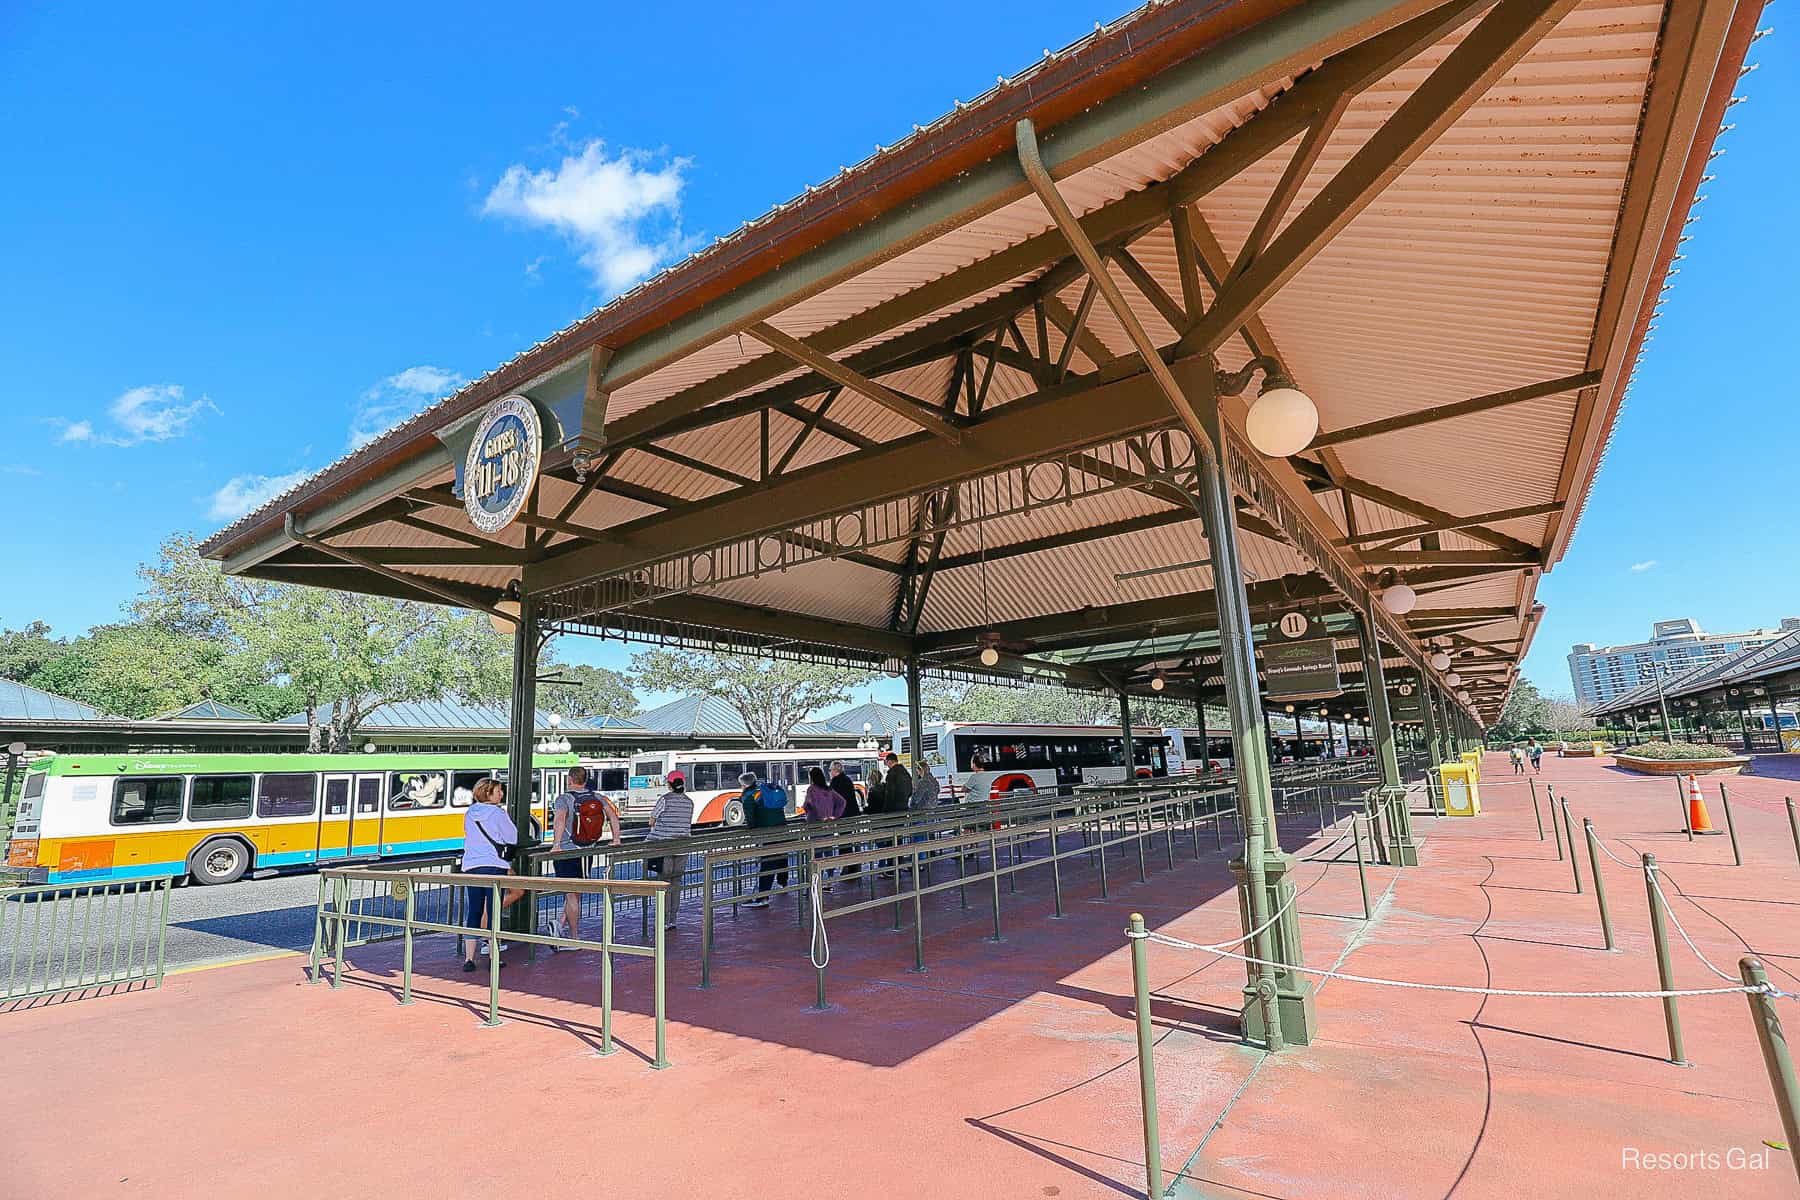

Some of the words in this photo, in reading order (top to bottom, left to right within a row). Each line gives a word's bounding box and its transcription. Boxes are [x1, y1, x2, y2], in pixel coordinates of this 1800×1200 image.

[476, 450, 521, 498] 11-18
[1288, 616, 1299, 632] 11
[1402, 686, 1409, 694] 12
